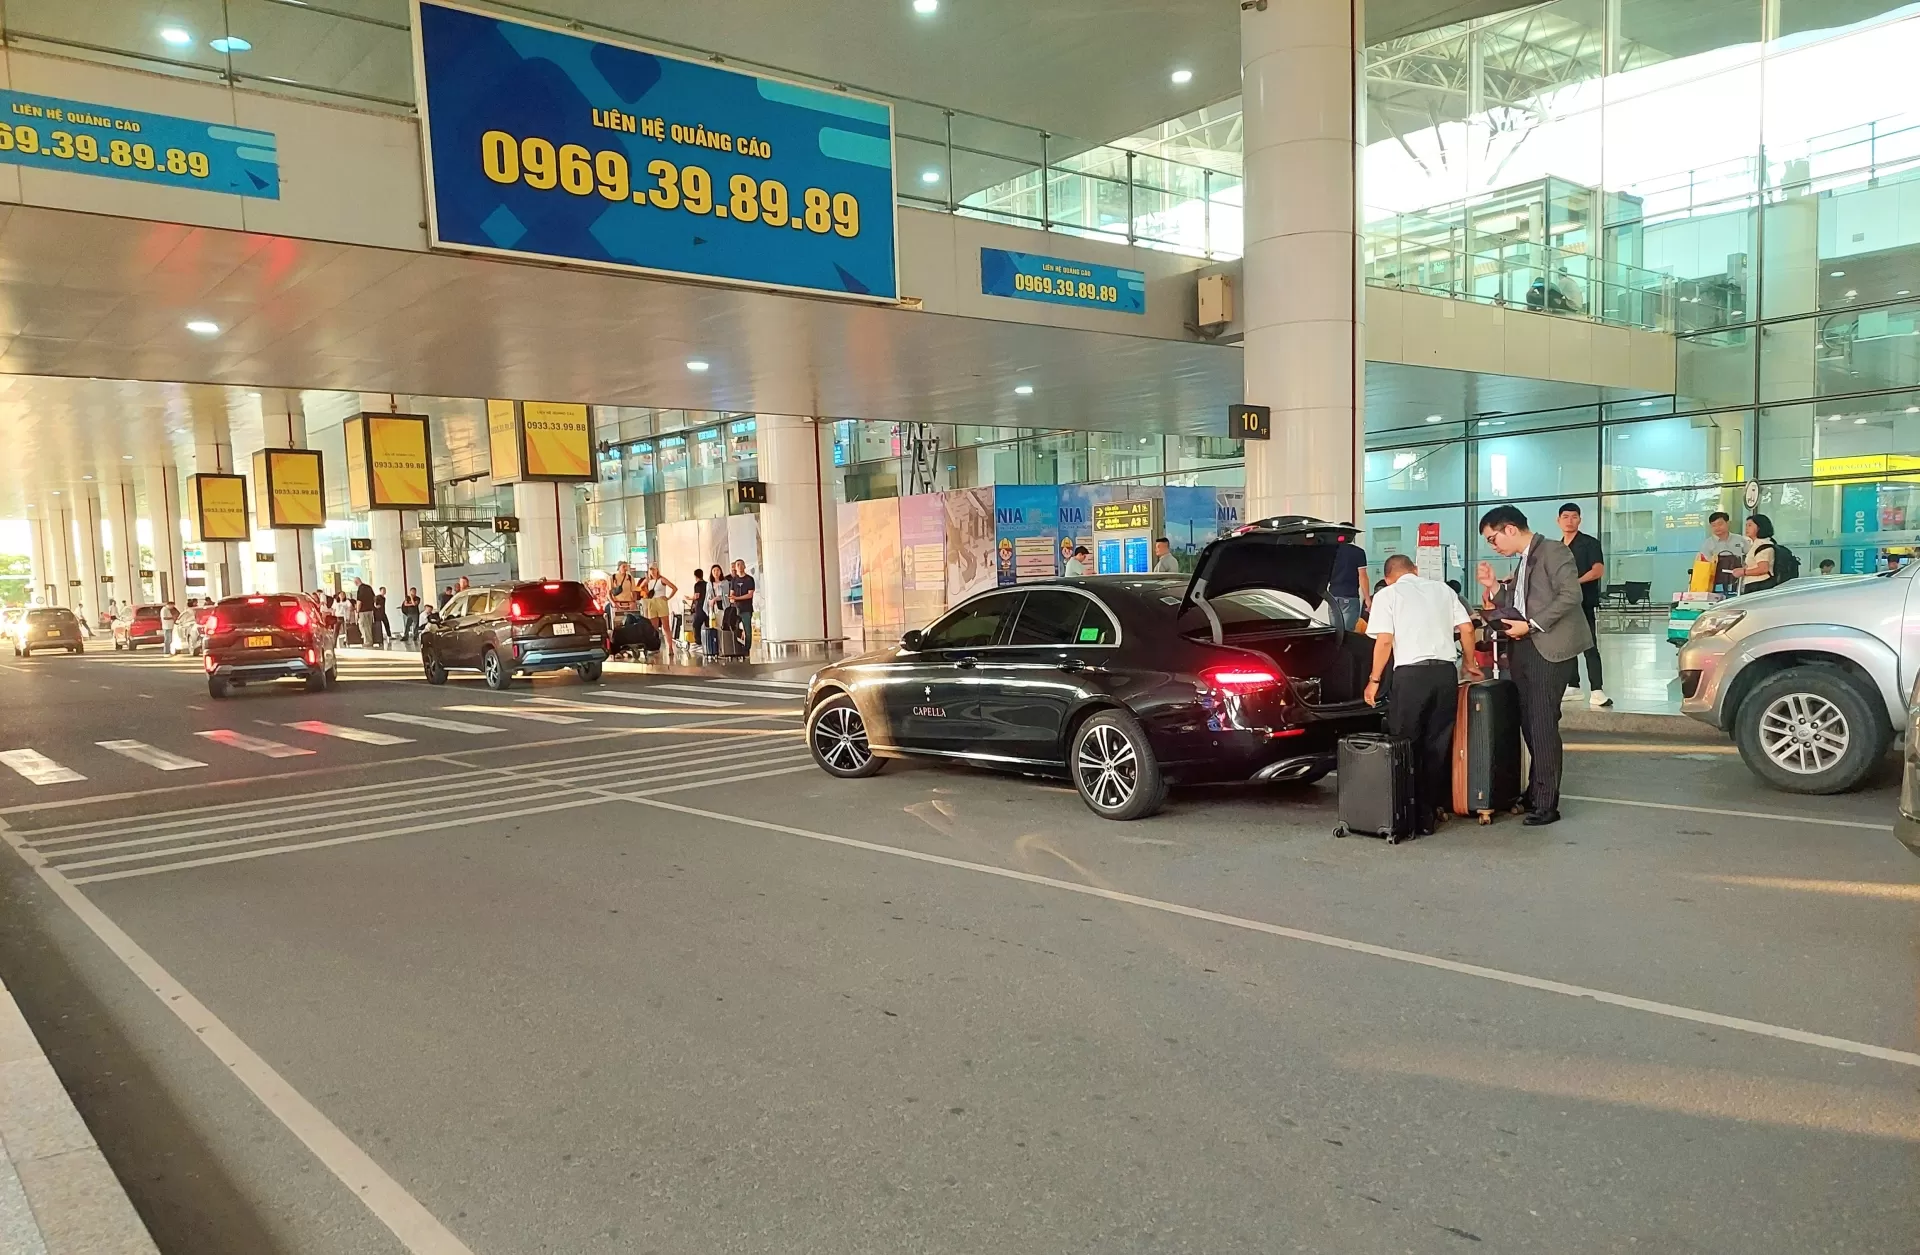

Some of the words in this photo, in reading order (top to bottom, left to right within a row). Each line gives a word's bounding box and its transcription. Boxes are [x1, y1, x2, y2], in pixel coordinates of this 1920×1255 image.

[12, 103, 43, 117] LIÊN
[46, 108, 64, 122] HỆ
[67, 111, 111, 129] QUẢNG
[115, 120, 141, 132] CÁO
[591, 108, 636, 133] LIÊN
[641, 117, 665, 142] HỆ
[670, 123, 732, 151] QUẢNG
[736, 135, 772, 159] CÁO
[481, 130, 860, 238] 0969.39.89.89
[1015, 273, 1117, 303] 0969.39.89.89
[526, 420, 587, 432] 0933.33.99.88
[1241, 412, 1259, 431] 10
[374, 461, 425, 470] 0933.33.99.88
[741, 486, 755, 499] 11
[998, 507, 1023, 523] NIA
[1060, 507, 1083, 522] NIA
[1131, 504, 1141, 513] A1
[1218, 506, 1238, 520] NIA
[497, 520, 510, 530] 12
[1130, 517, 1142, 527] A2
[353, 540, 364, 549] 13
[912, 706, 947, 718] CAPELLA
